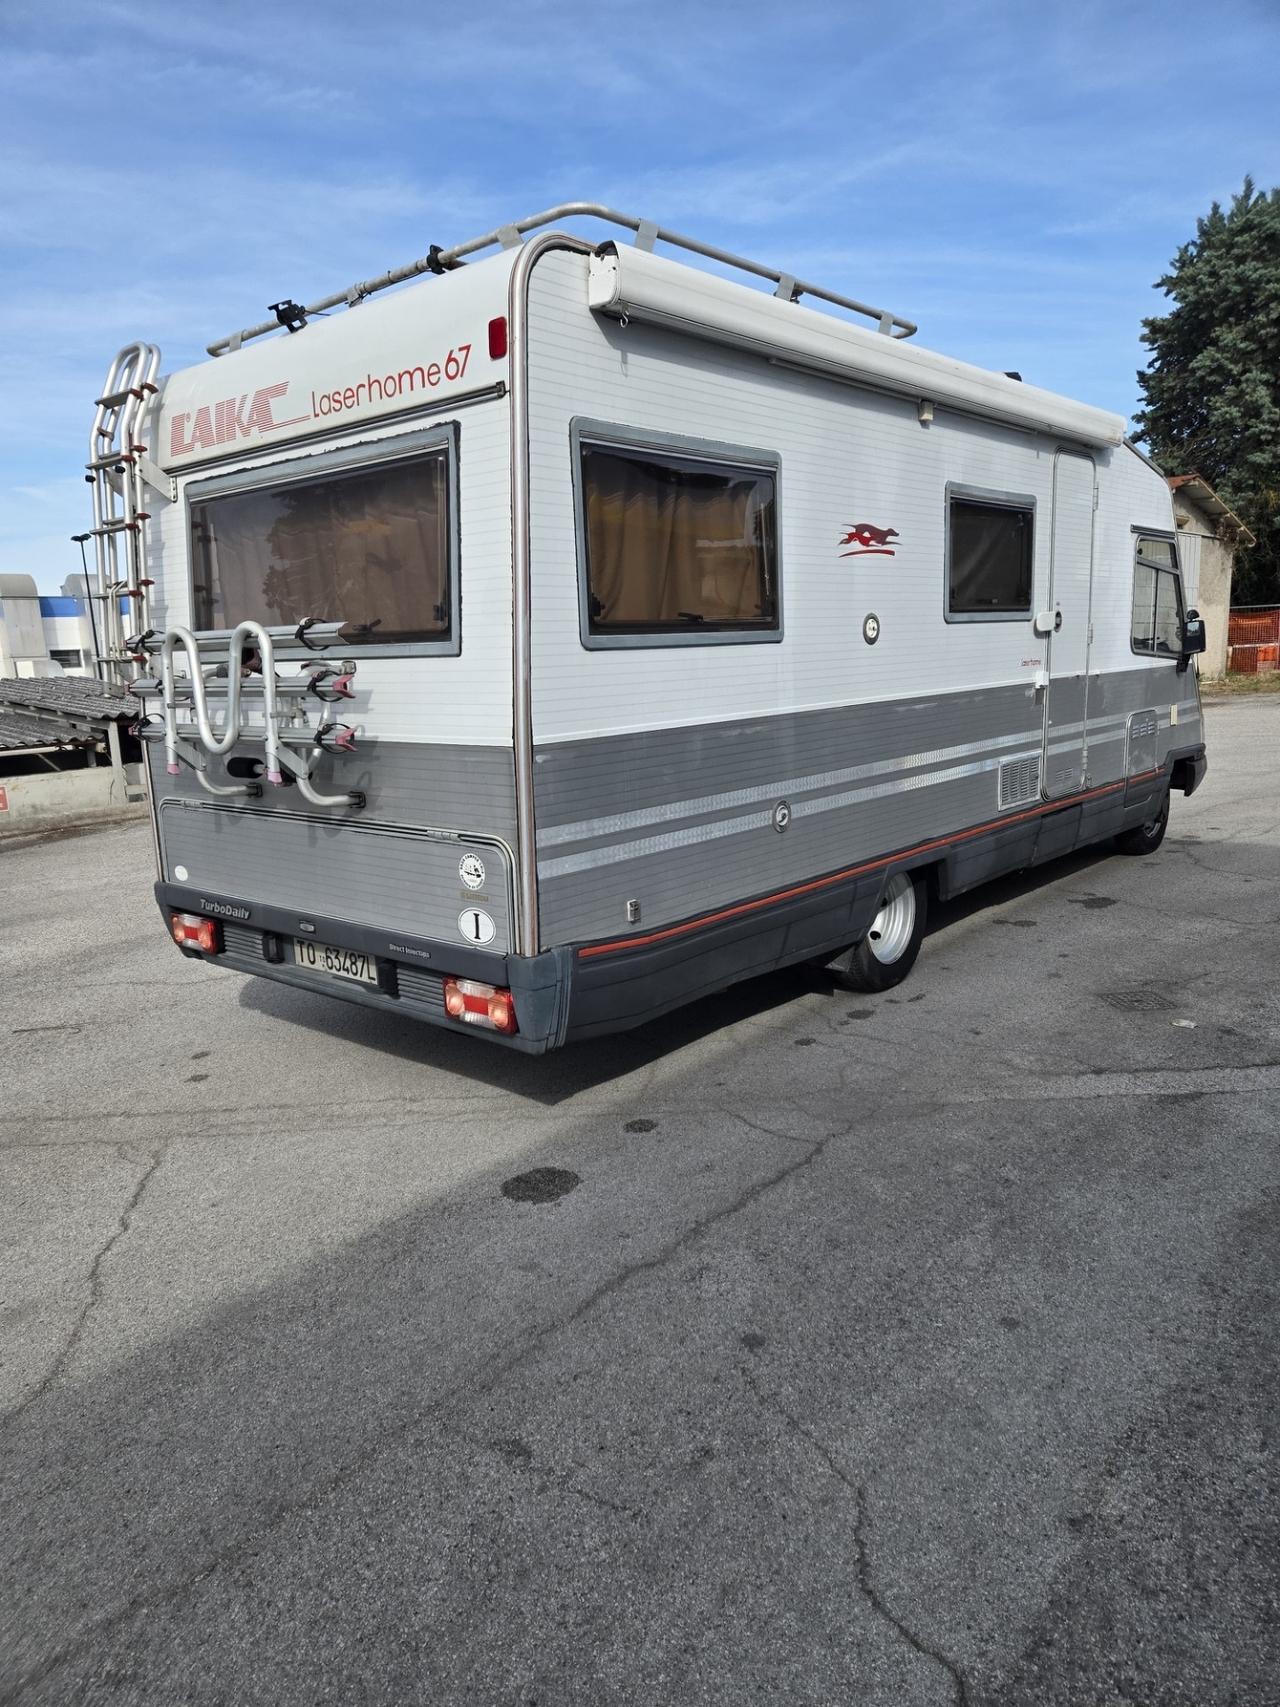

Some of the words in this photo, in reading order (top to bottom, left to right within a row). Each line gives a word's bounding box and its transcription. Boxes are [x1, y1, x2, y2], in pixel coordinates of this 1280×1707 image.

[200, 898, 250, 920] TurboDaily
[296, 939, 316, 965] TO
[325, 946, 376, 981] 63487L
